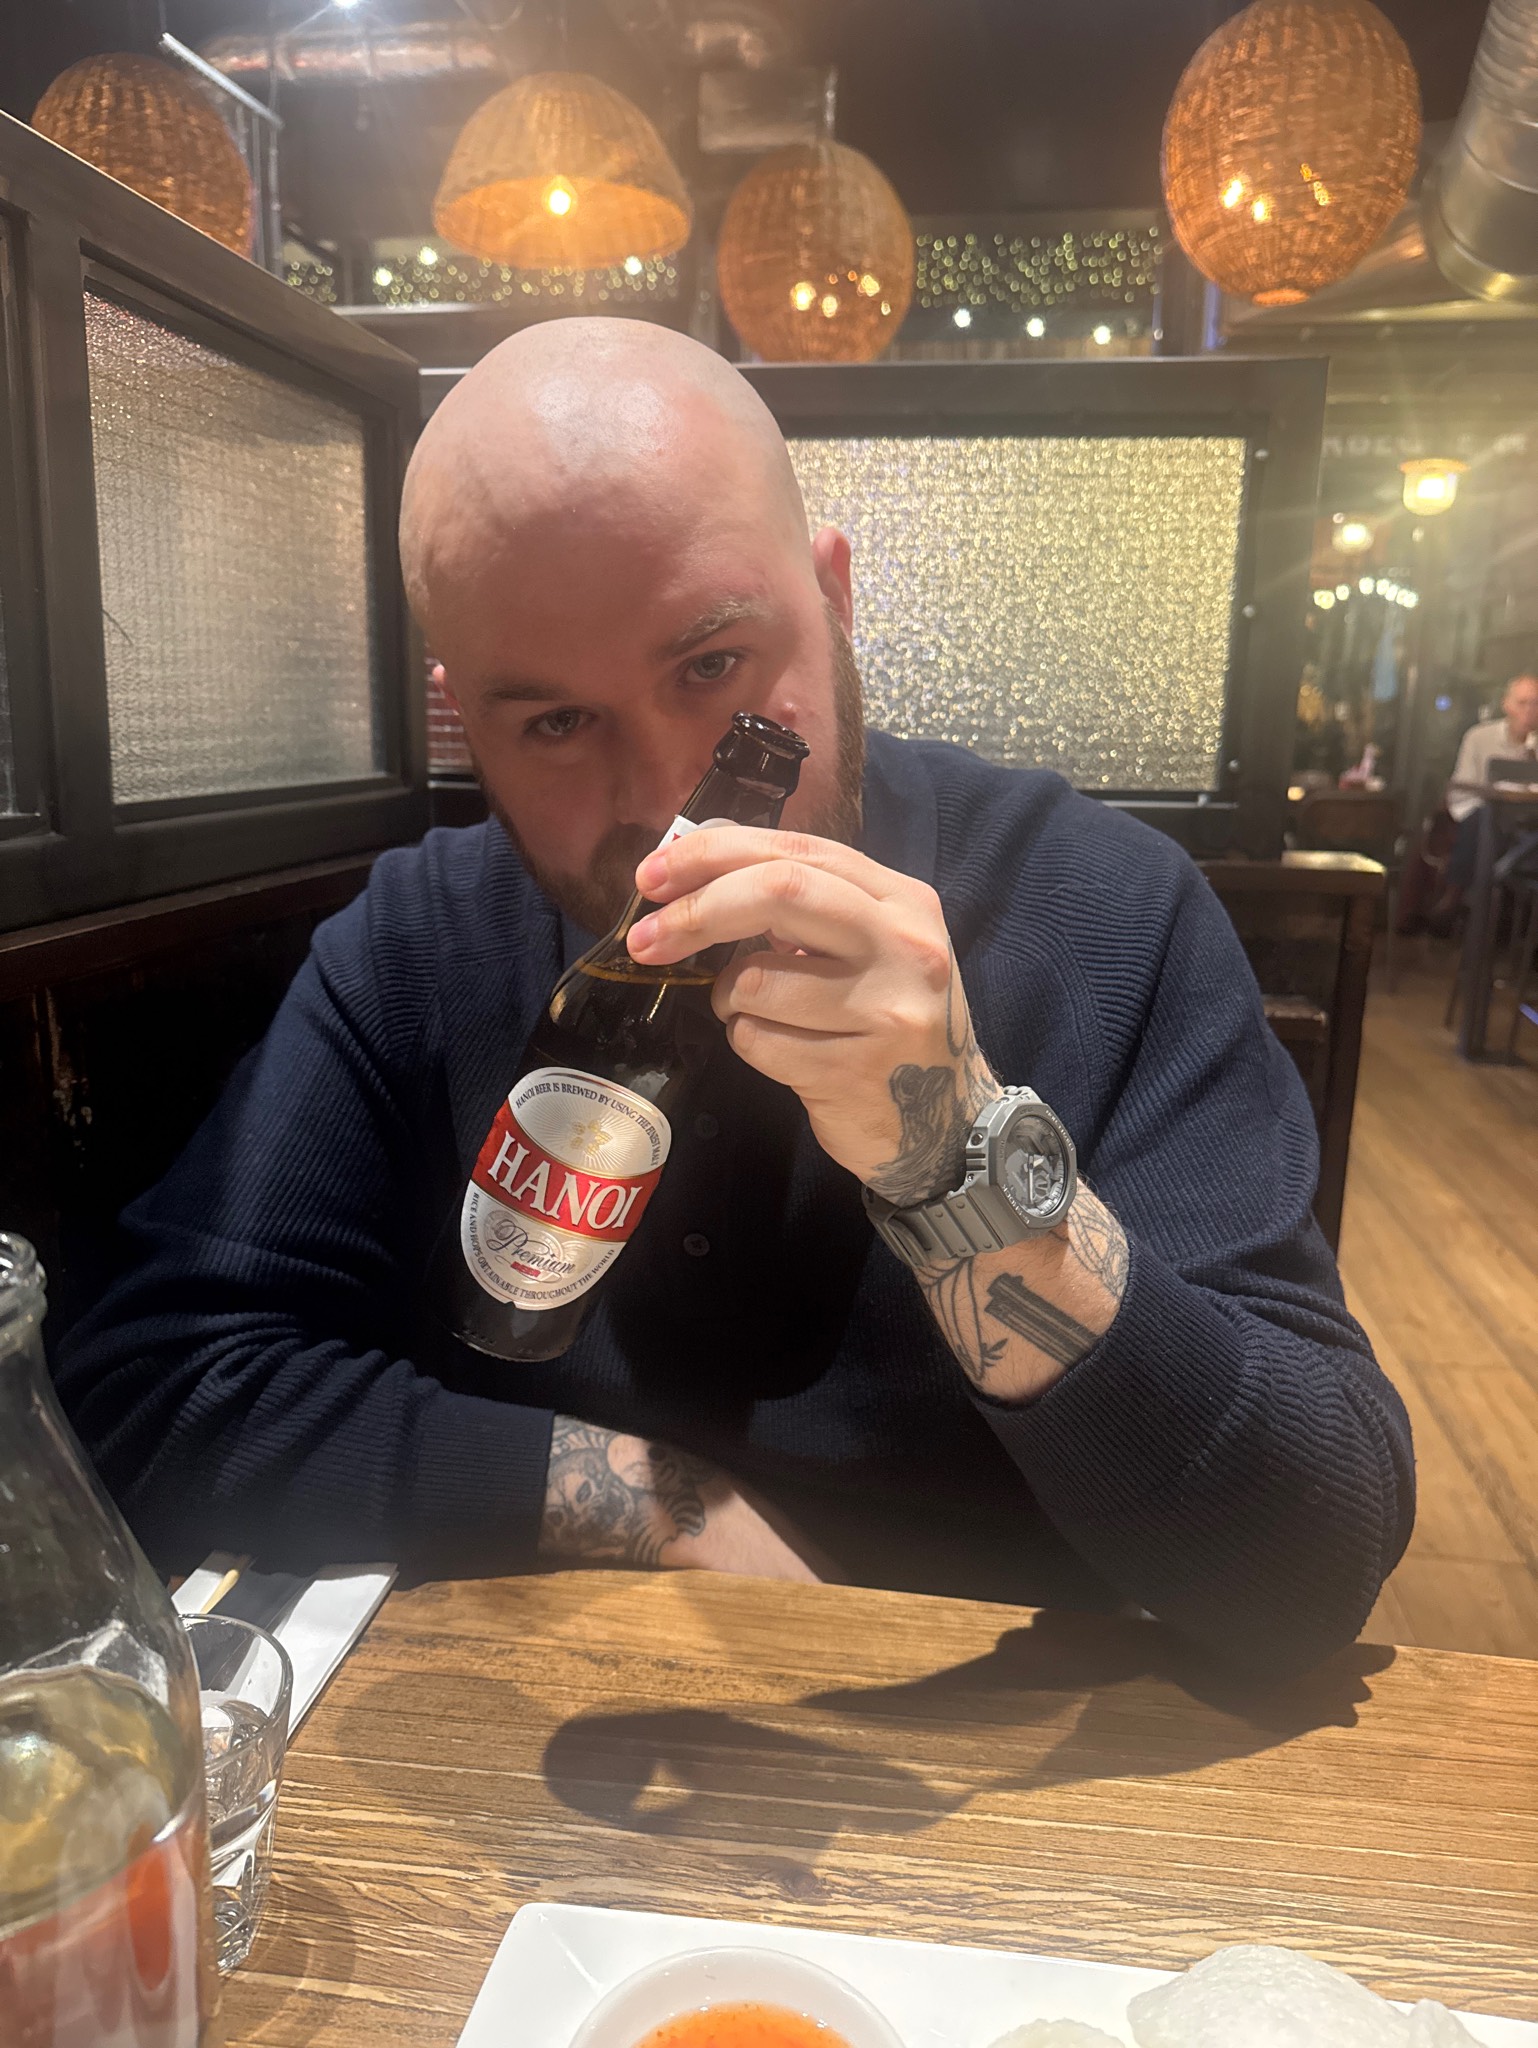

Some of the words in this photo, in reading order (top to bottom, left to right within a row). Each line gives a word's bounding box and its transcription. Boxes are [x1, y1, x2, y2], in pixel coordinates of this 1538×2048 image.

[515, 1088, 535, 1109] HANOI
[535, 1082, 552, 1095] BEER
[552, 1082, 560, 1092] IS
[561, 1082, 598, 1100] BREWED
[598, 1094, 612, 1106] BY
[610, 1099, 638, 1119] USING
[635, 1114, 651, 1130] THE
[487, 1130, 643, 1230] HANOI
[470, 1192, 479, 1212] RICE
[469, 1214, 478, 1233] AND
[486, 1218, 576, 1274] Premium
[578, 1273, 593, 1286] THE
[519, 1284, 579, 1300] THROUGHOUT
